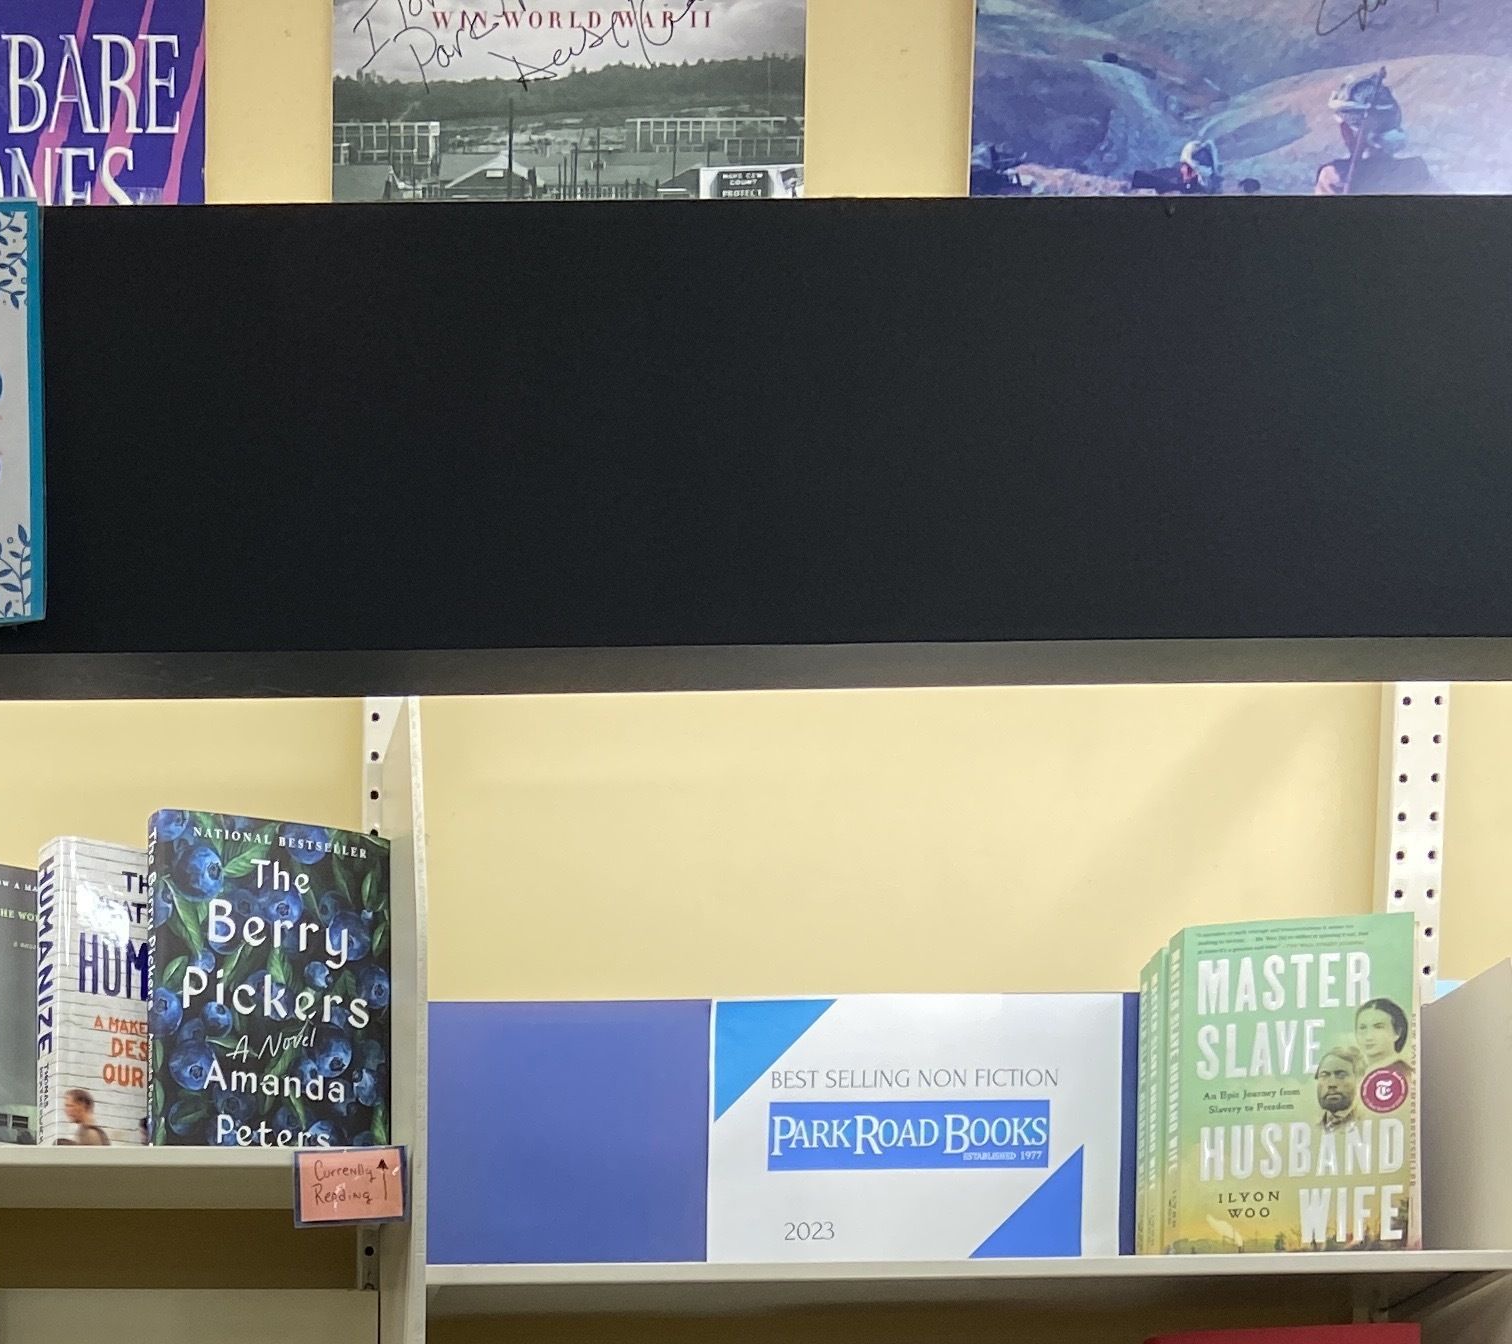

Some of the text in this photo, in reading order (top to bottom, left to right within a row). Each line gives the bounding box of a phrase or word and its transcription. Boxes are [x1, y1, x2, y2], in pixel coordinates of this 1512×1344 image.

[504, 10, 601, 28] WORLD
[618, 11, 676, 28] WAR
[691, 11, 711, 28] II
[1, 34, 181, 135] BARE
[193, 827, 367, 859] NATIONAL BESTSELLER
[251, 859, 310, 894] The
[208, 900, 349, 970] Berry
[182, 967, 369, 1029] Pickers
[1197, 951, 1370, 1015] MASTER
[226, 1022, 316, 1061] A Novel
[1196, 1019, 1325, 1080] SLAVE
[203, 1060, 345, 1103] Amanda
[772, 1069, 1059, 1088] BEST SELLING NON FICTION
[217, 1115, 330, 1147] Peters
[771, 1114, 1047, 1156] PARK ROAD BOOKS
[1200, 1119, 1404, 1181] HUSBAND
[1020, 1151, 1042, 1160] 1977
[1219, 1192, 1280, 1203] ILYON
[1228, 1208, 1270, 1218] WOO
[1299, 1185, 1403, 1243] WIFE
[784, 1222, 835, 1240] 2023
